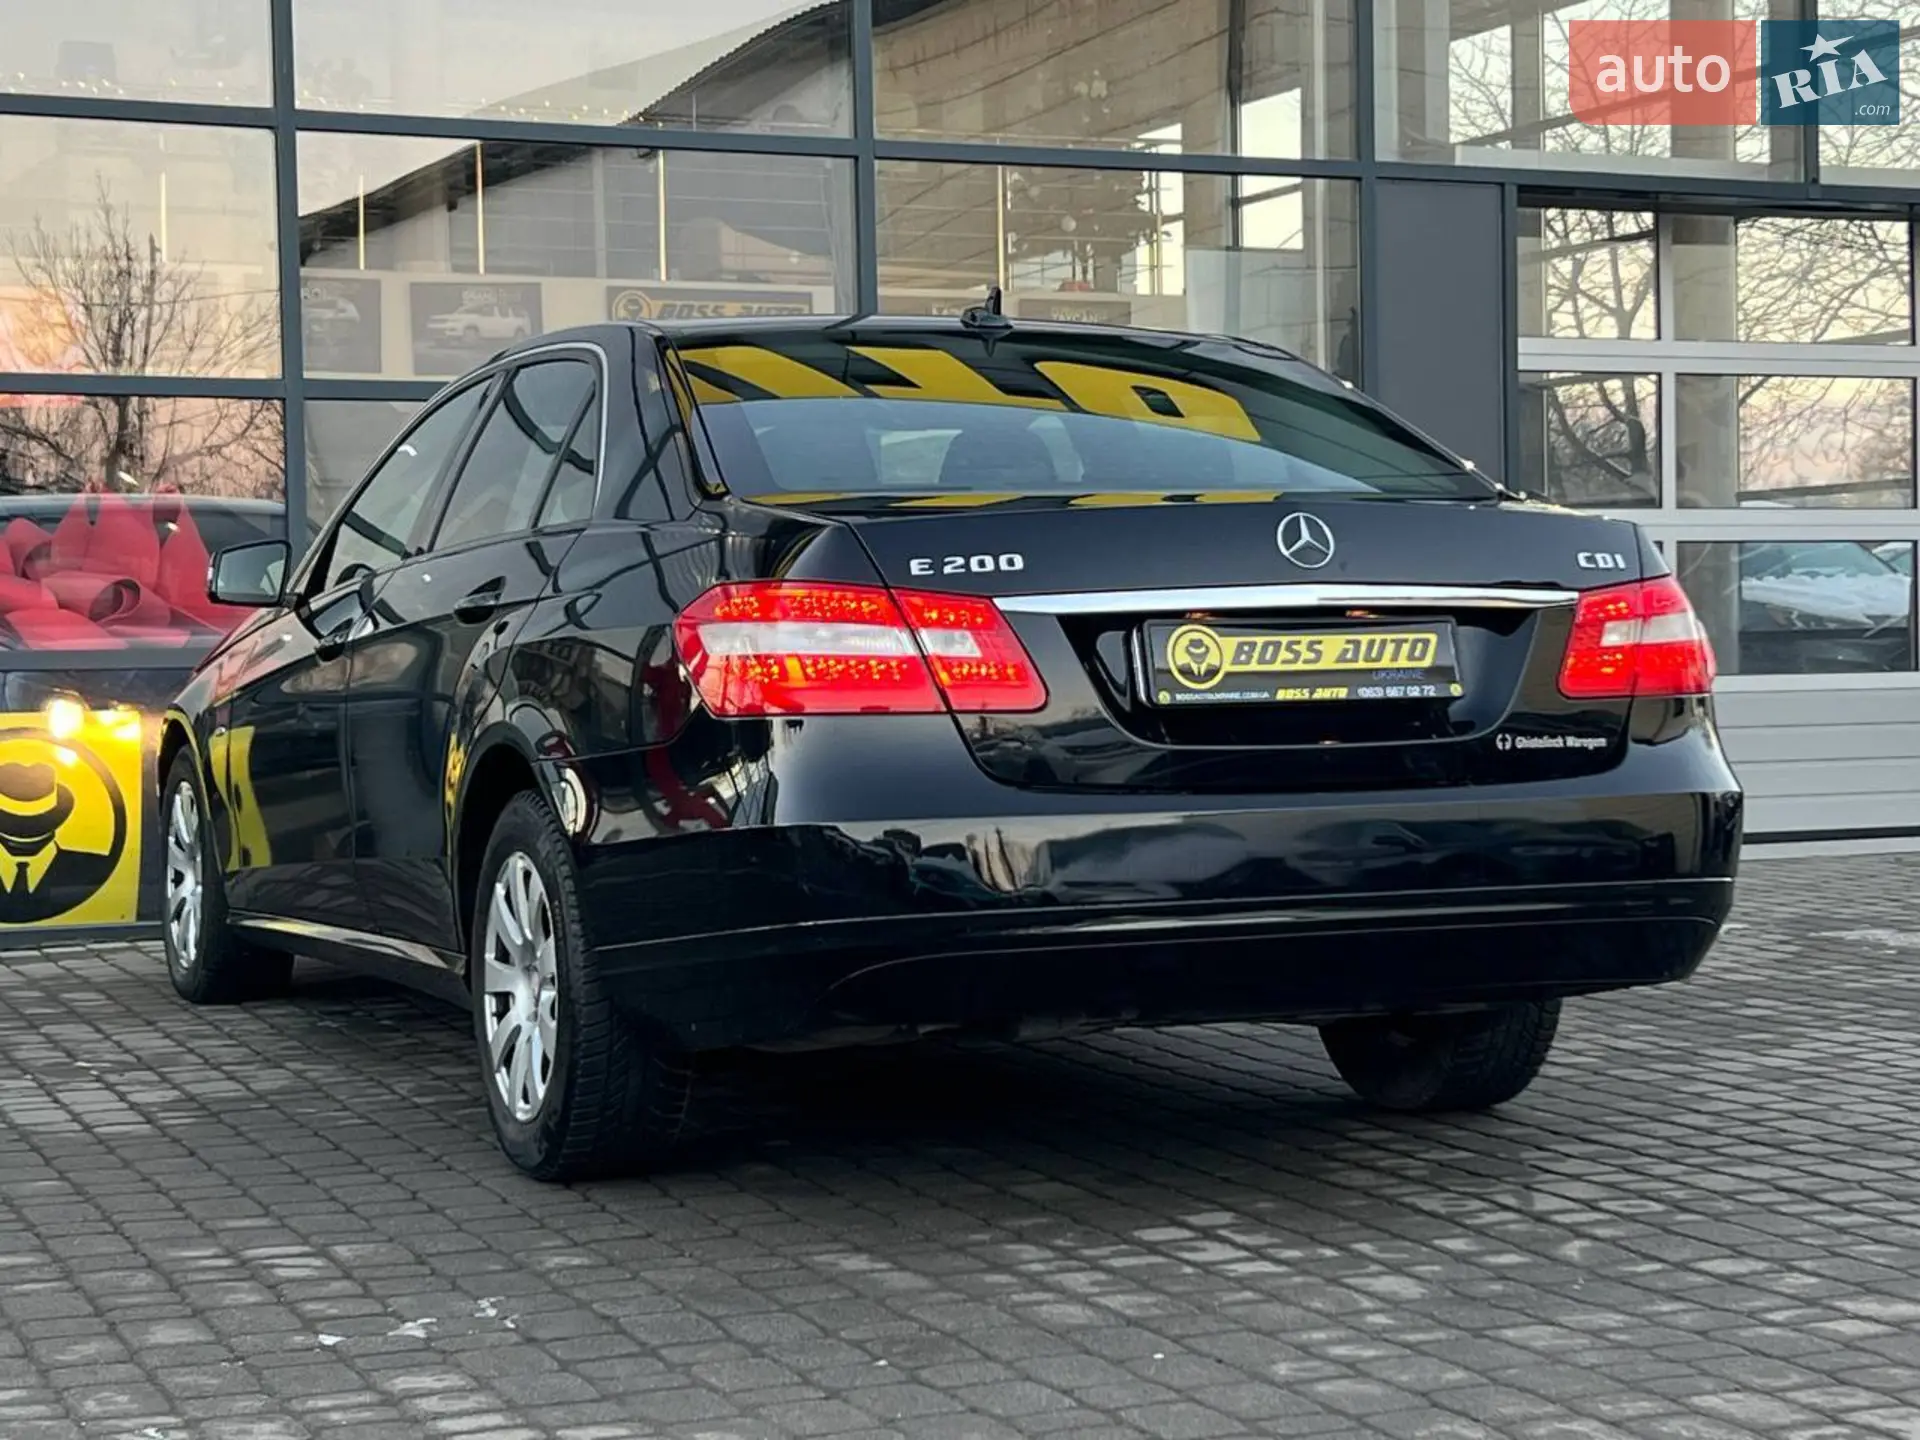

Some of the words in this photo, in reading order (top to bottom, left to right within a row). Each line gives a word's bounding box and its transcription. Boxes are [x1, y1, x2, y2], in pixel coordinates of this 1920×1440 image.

[909, 558, 935, 576] E
[943, 553, 1024, 574] 200
[1577, 552, 1627, 569] CDI
[1229, 639, 1323, 666] BOSS
[1334, 637, 1432, 664] AUTO
[1275, 688, 1310, 700] BOSS
[1312, 687, 1348, 699] AUTO
[1421, 684, 1436, 697] 72
